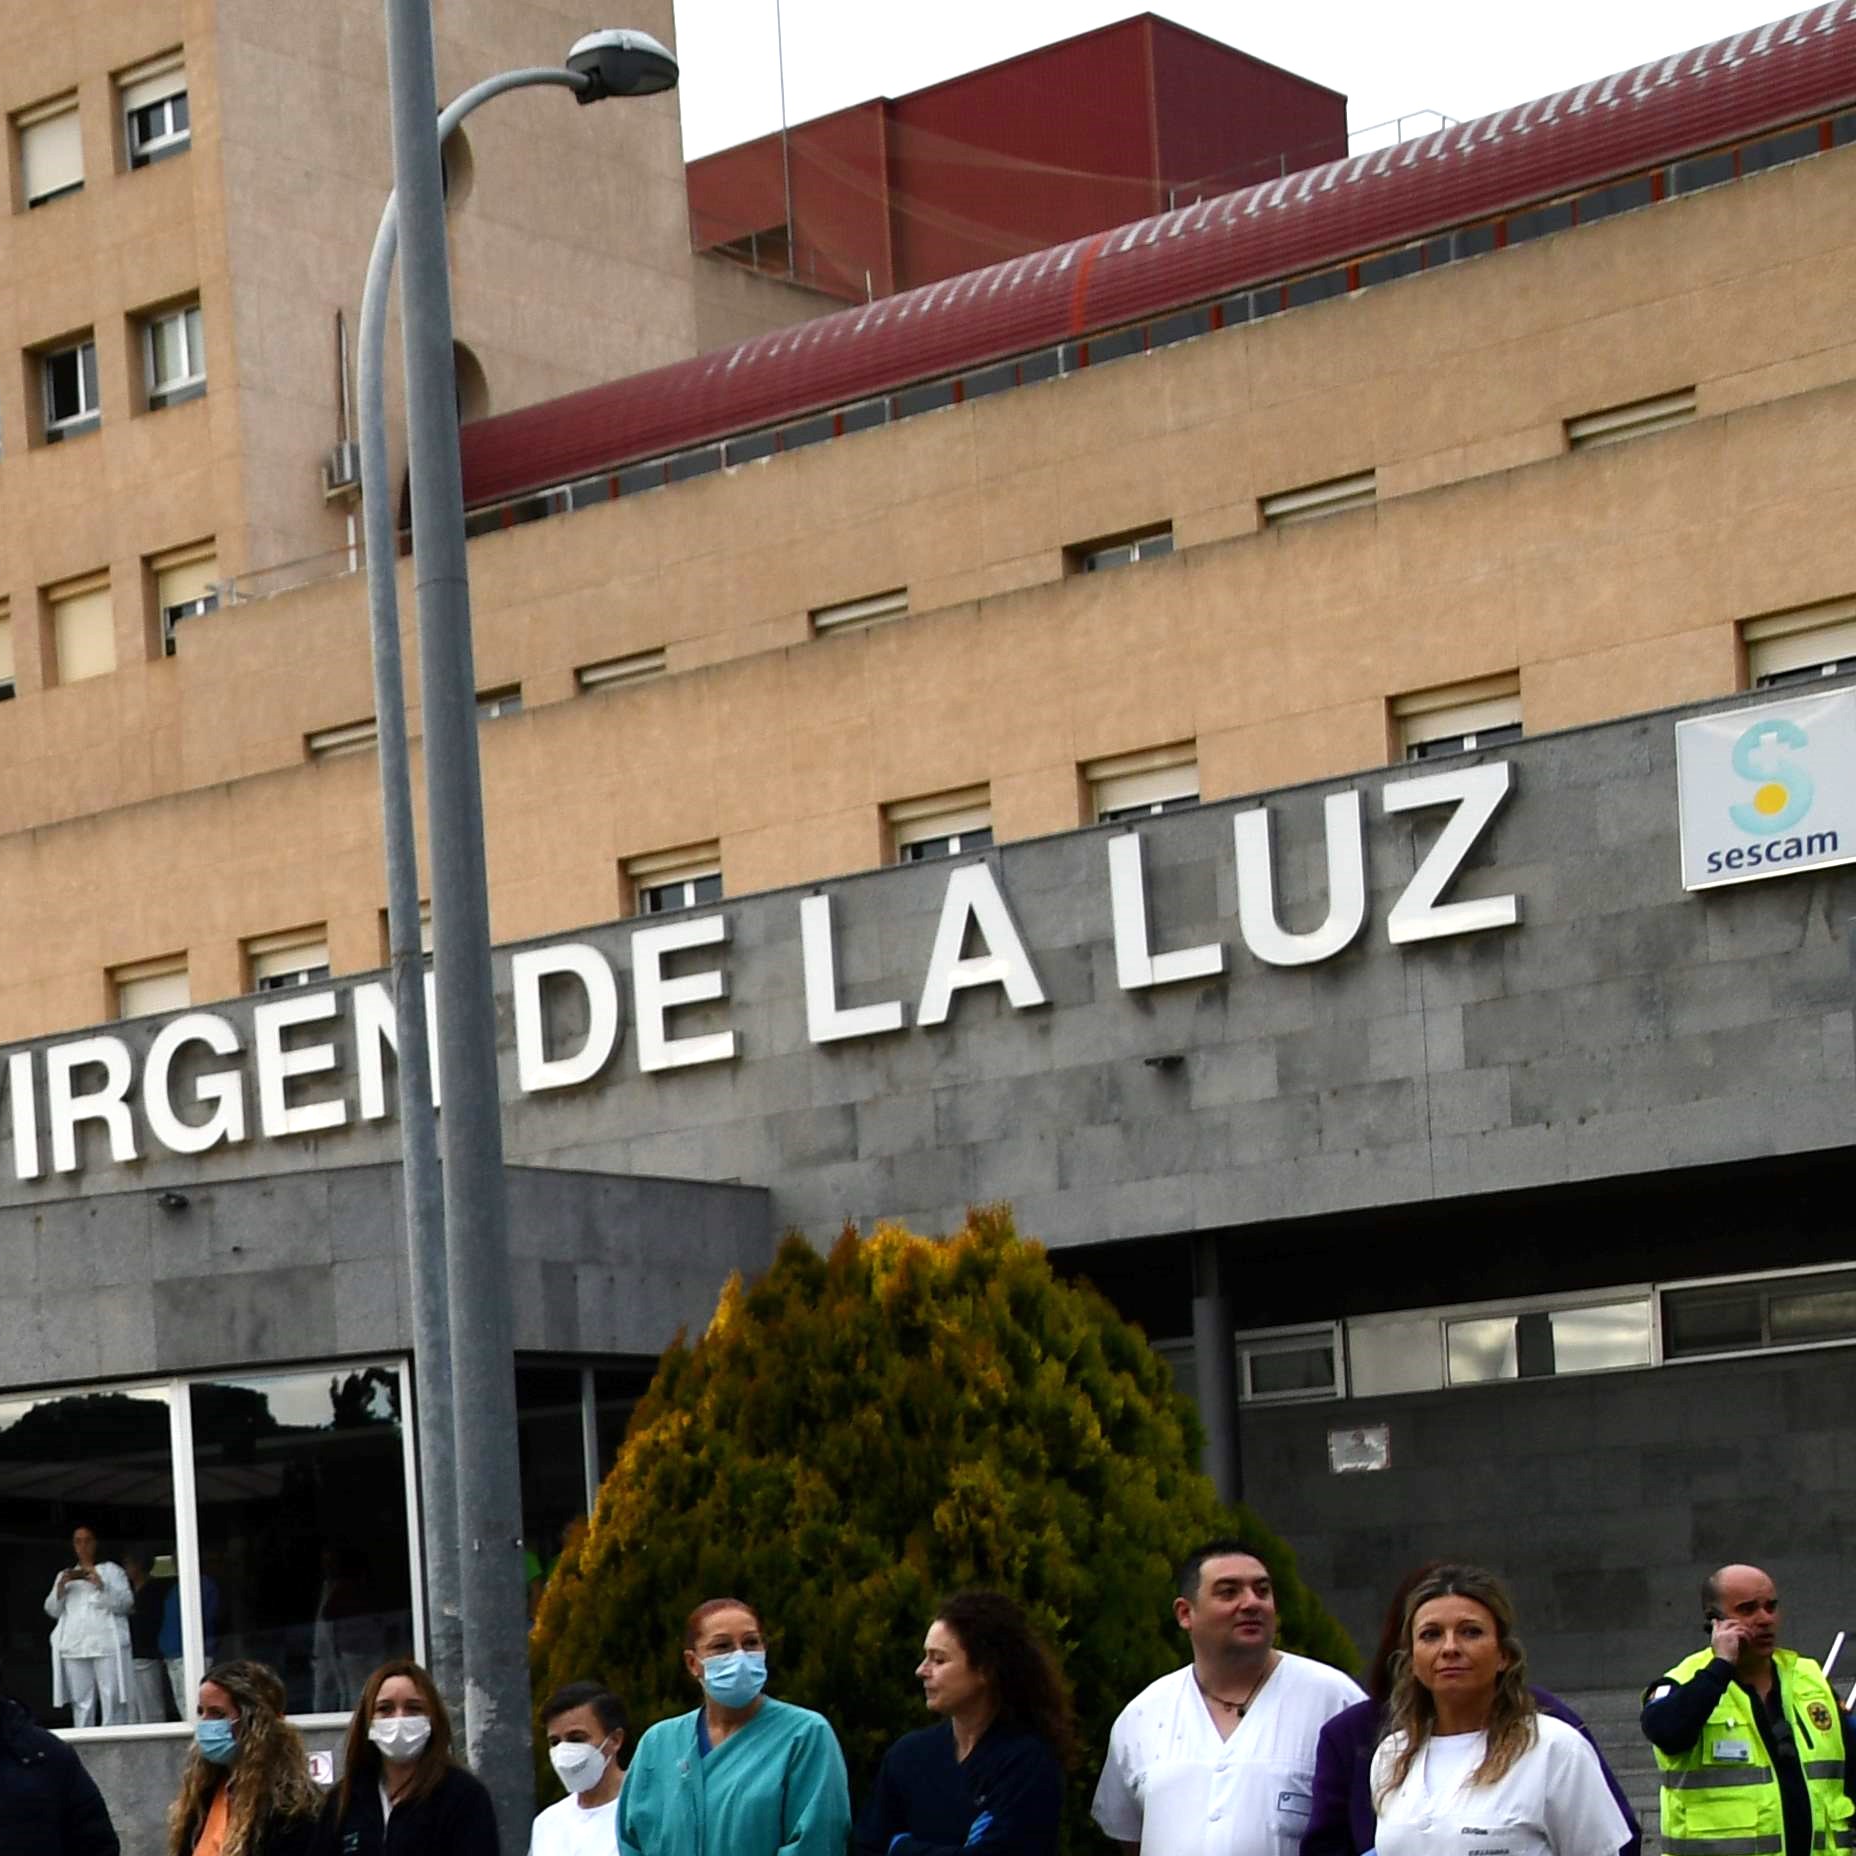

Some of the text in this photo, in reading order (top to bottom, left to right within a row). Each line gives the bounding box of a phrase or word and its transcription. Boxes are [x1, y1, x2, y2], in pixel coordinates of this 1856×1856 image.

[511, 913, 737, 1093] DE
[800, 861, 1050, 1044] LA
[1107, 760, 1524, 990] LUZ
[1706, 830, 1839, 874] sescam
